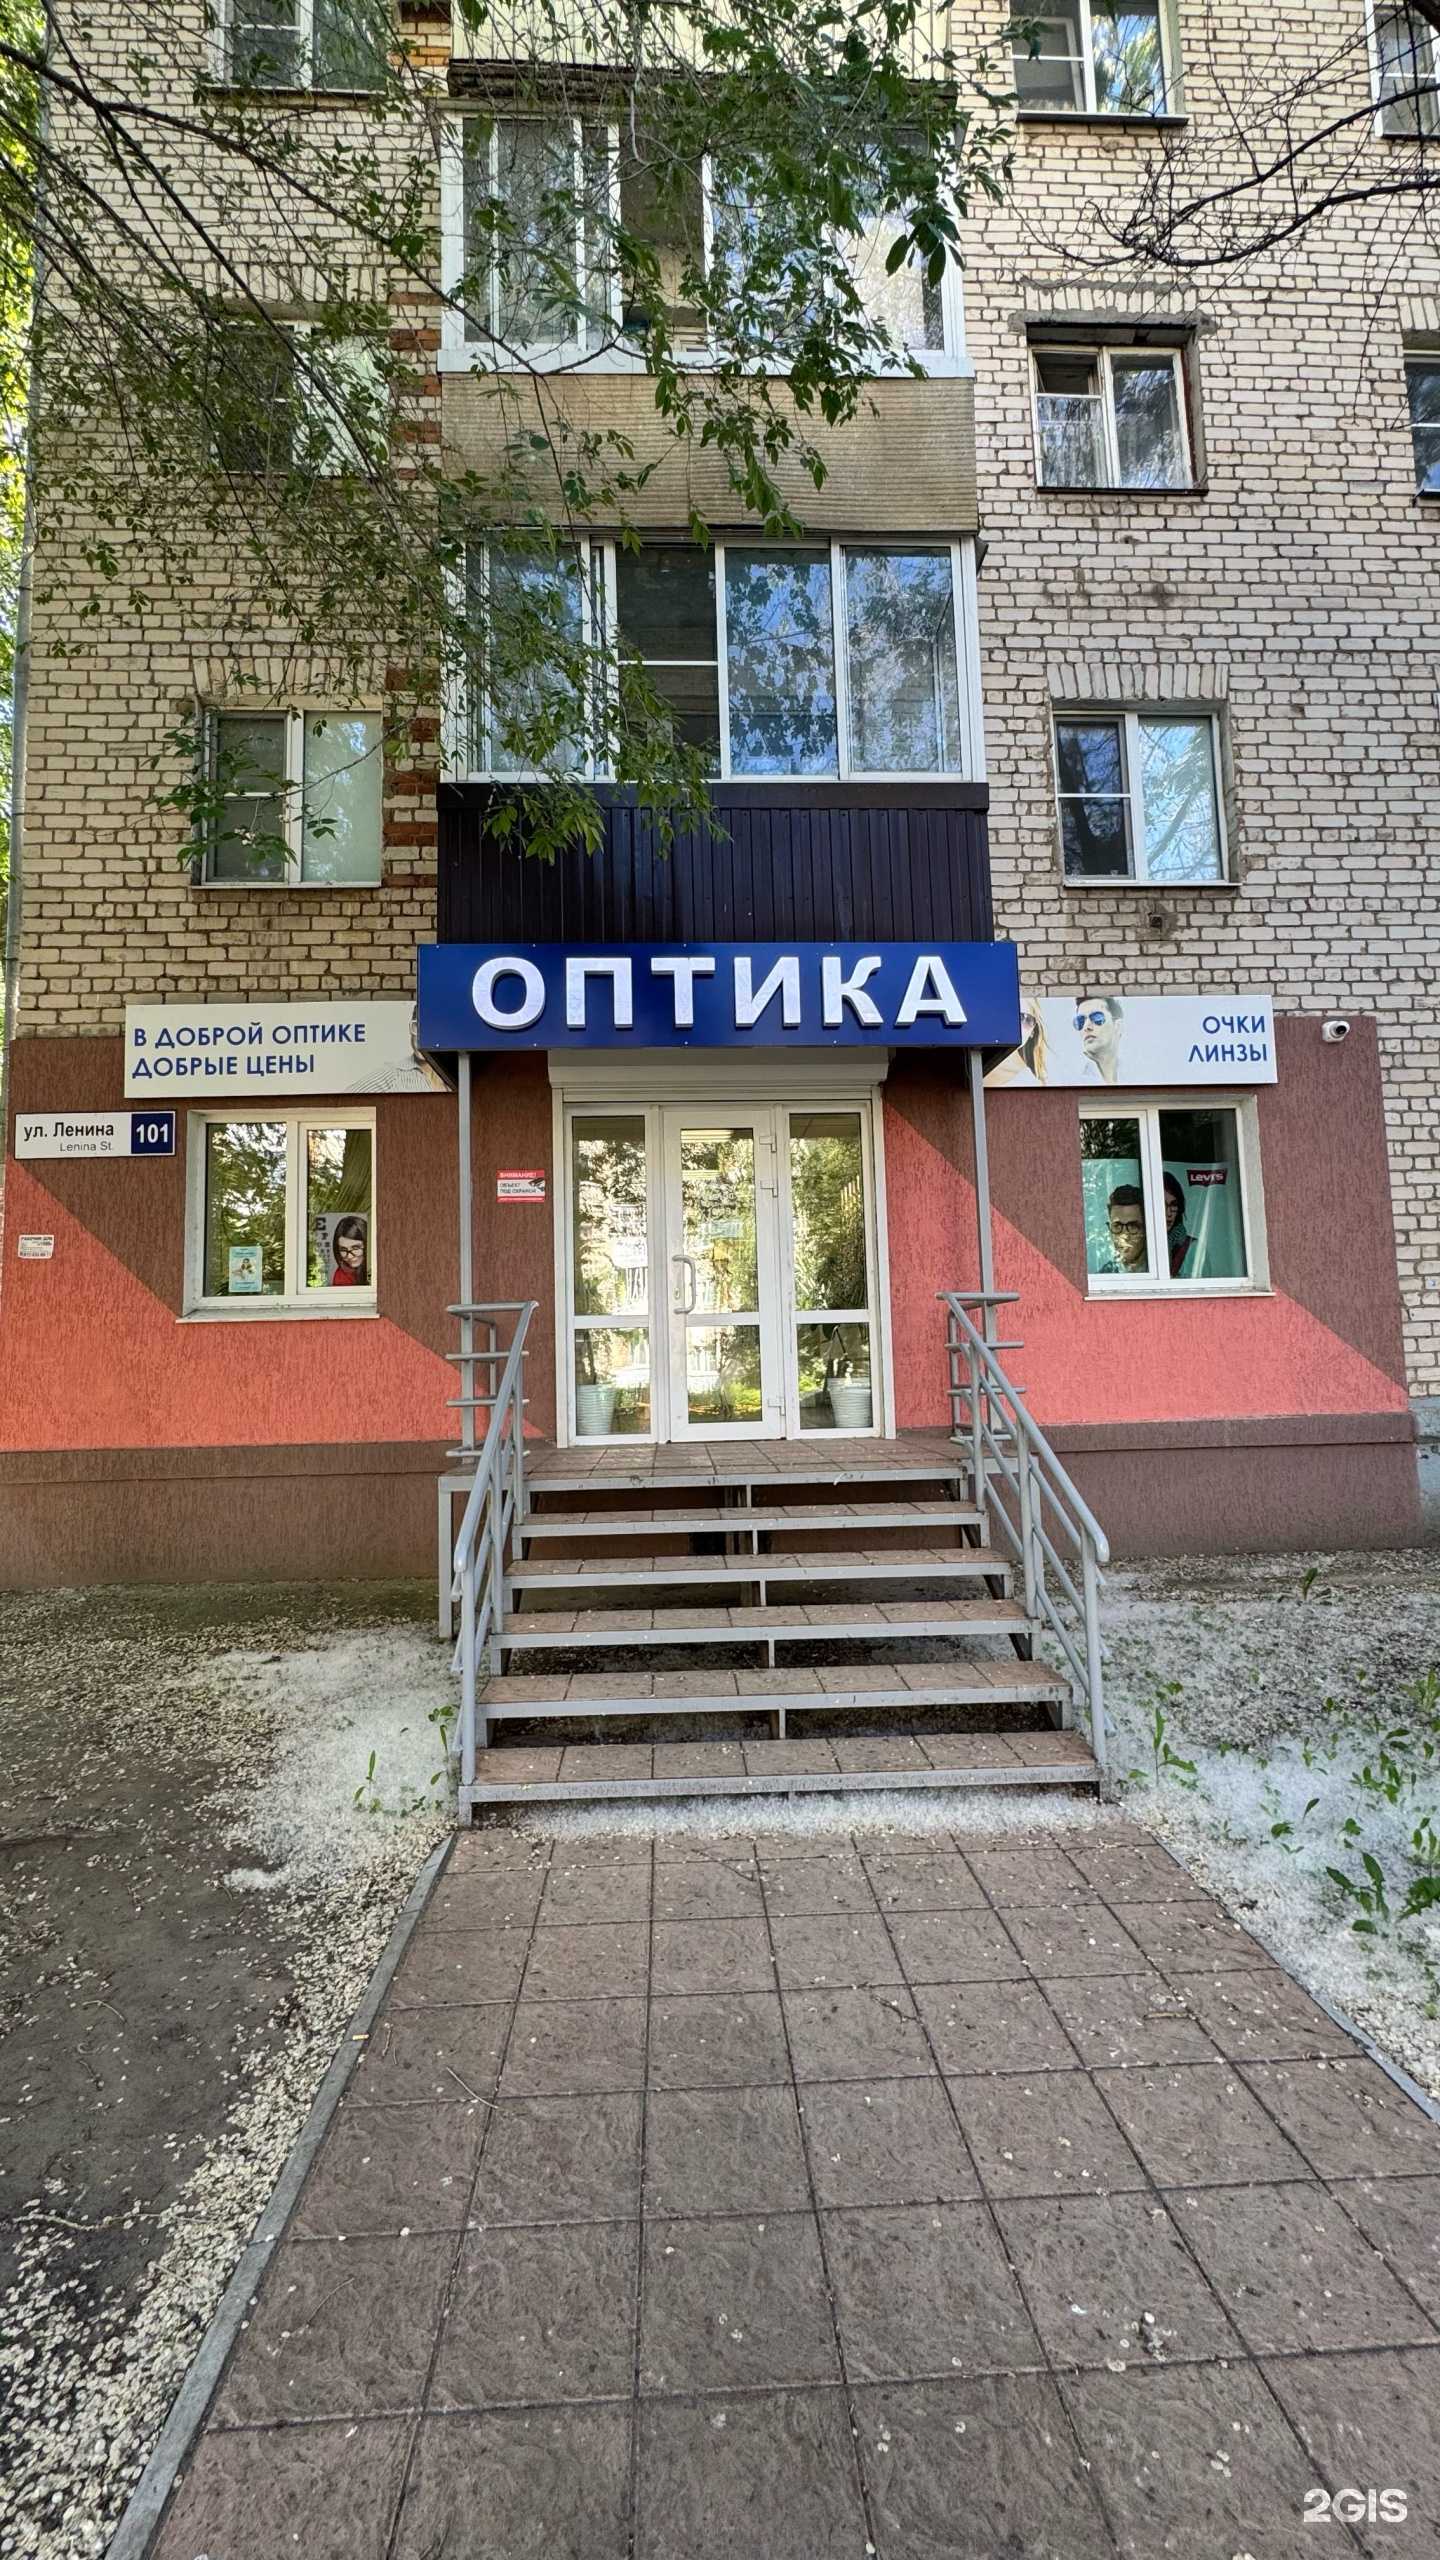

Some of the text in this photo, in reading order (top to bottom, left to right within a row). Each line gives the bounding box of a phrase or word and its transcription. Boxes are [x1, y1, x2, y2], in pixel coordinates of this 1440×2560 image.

[471, 956, 968, 1030] ОПТИКА
[1202, 1015, 1265, 1034] ОЧКИ
[134, 1022, 366, 1049] В ДОБРОЙ ОПТИКЕ
[1188, 1043, 1267, 1062] ЛИНЗЫ
[132, 1054, 315, 1079] ДОБРЫЕ ЦЕНЫ
[24, 1122, 114, 1141] ул. Ленина
[136, 1123, 169, 1143] 101
[60, 1142, 97, 1152] Lenina
